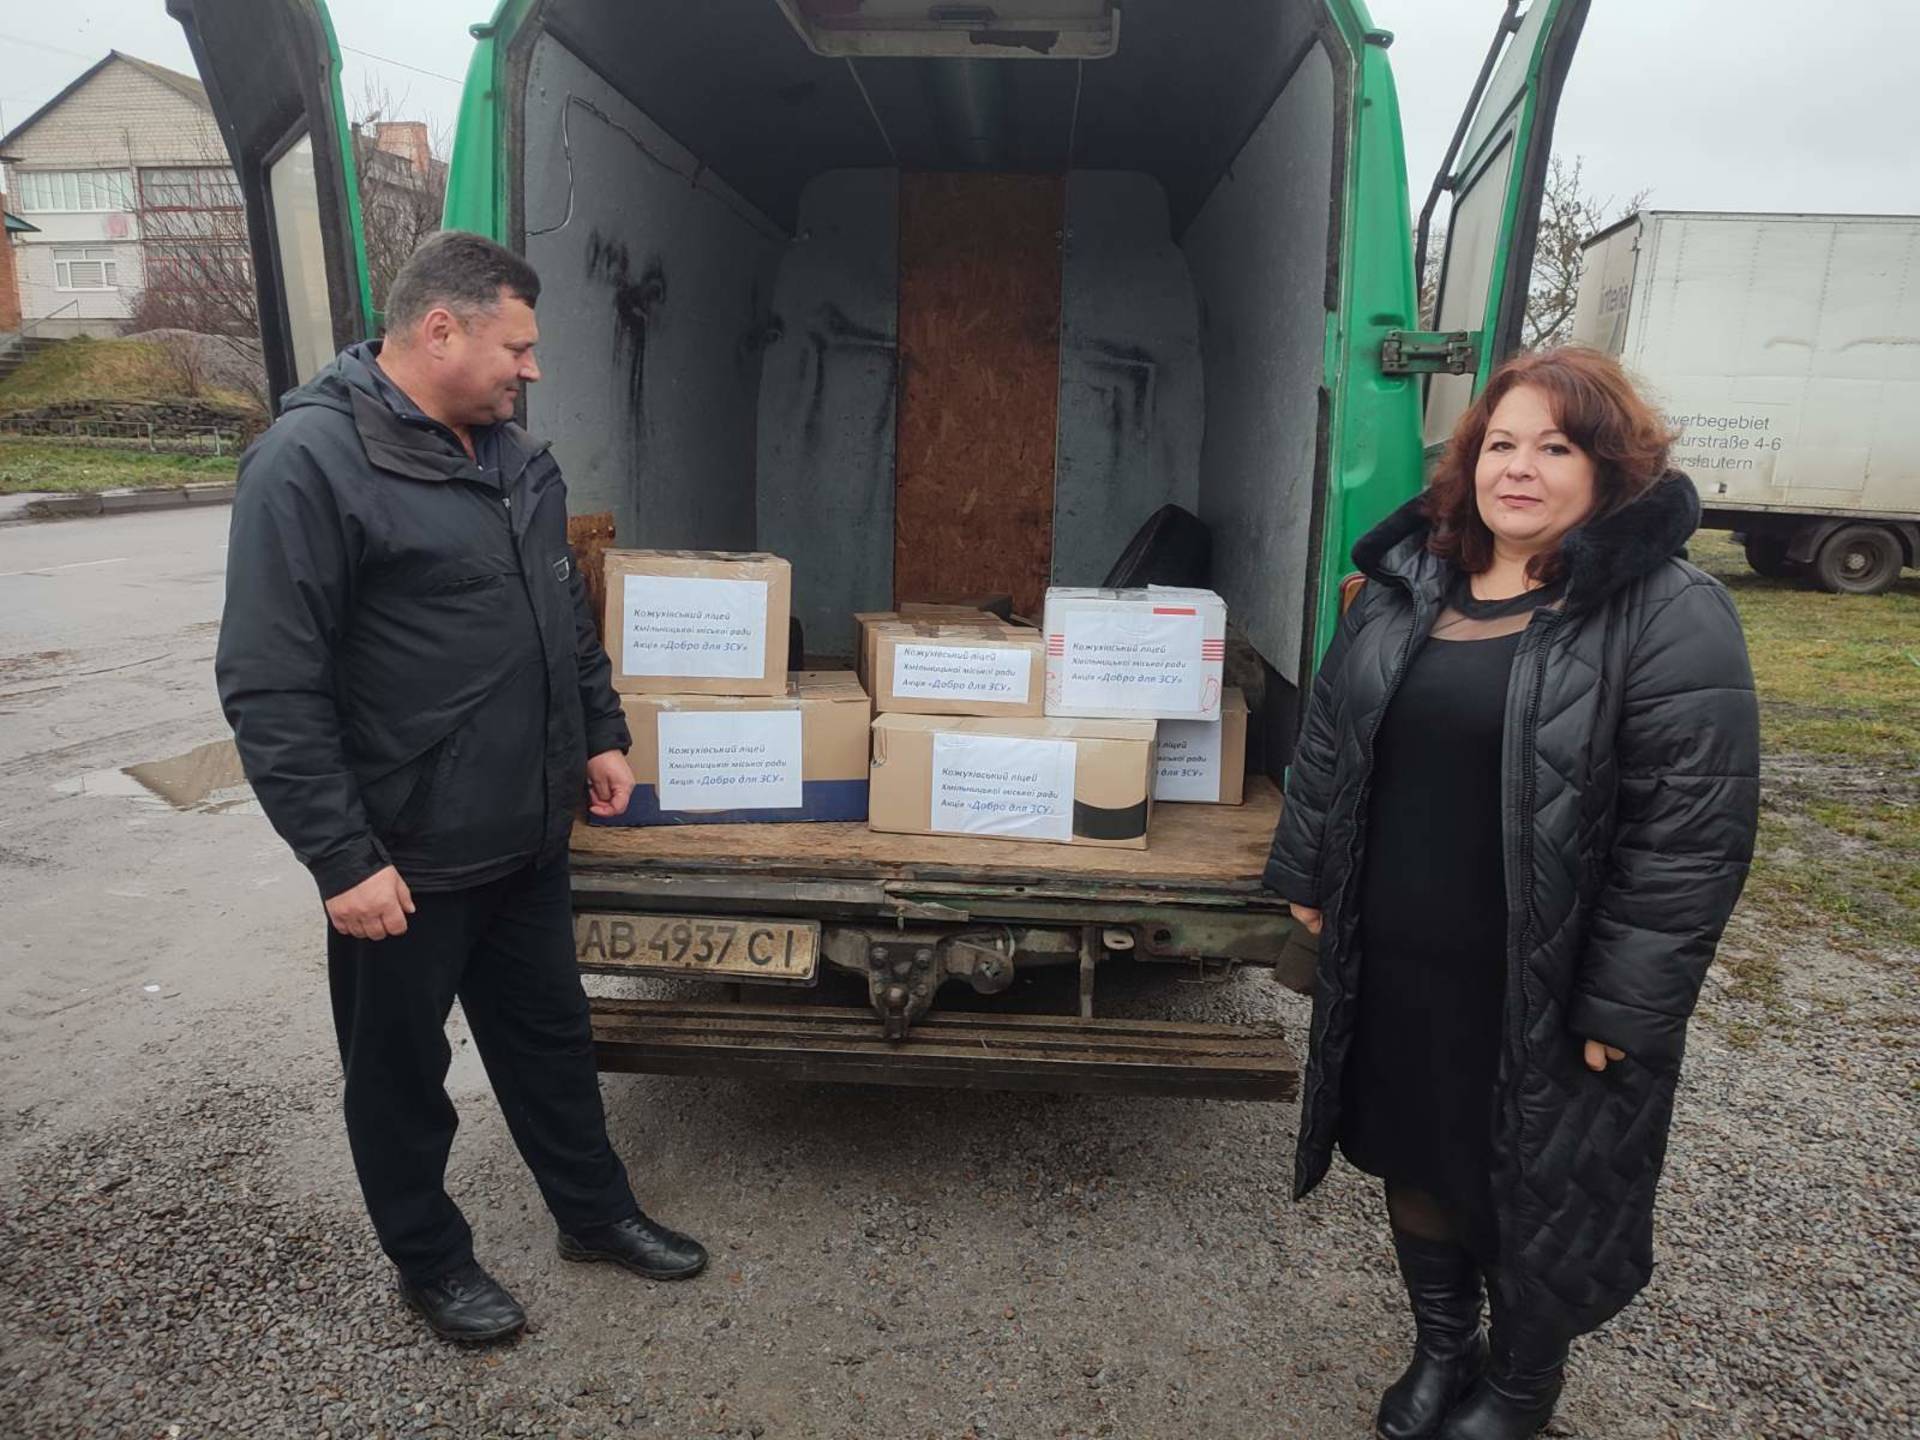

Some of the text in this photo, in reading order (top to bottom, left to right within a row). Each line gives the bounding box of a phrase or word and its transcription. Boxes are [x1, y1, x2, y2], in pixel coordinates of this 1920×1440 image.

[1676, 434, 1782, 451] urstraße 4-6
[634, 608, 731, 621] Кожухівський ліцей
[729, 628, 752, 636] ради
[701, 642, 721, 651] для
[1072, 642, 1166, 654] Кожухівський ліцей
[902, 647, 996, 661] Кожухівський ліцей
[1164, 661, 1186, 669] ради
[994, 669, 1016, 677] ради
[1137, 674, 1157, 683] для
[967, 681, 987, 690] для
[668, 743, 766, 756] Кожухівський ліцей
[1162, 741, 1188, 750] ліцей
[764, 760, 787, 768] ради
[1186, 755, 1207, 764] ради
[942, 768, 1038, 783] Кожухівський ліцей
[1160, 768, 1180, 777] для
[737, 774, 757, 784] для
[1036, 790, 1059, 799] ради
[1008, 803, 1029, 812] для
[647, 922, 738, 965] 4937
